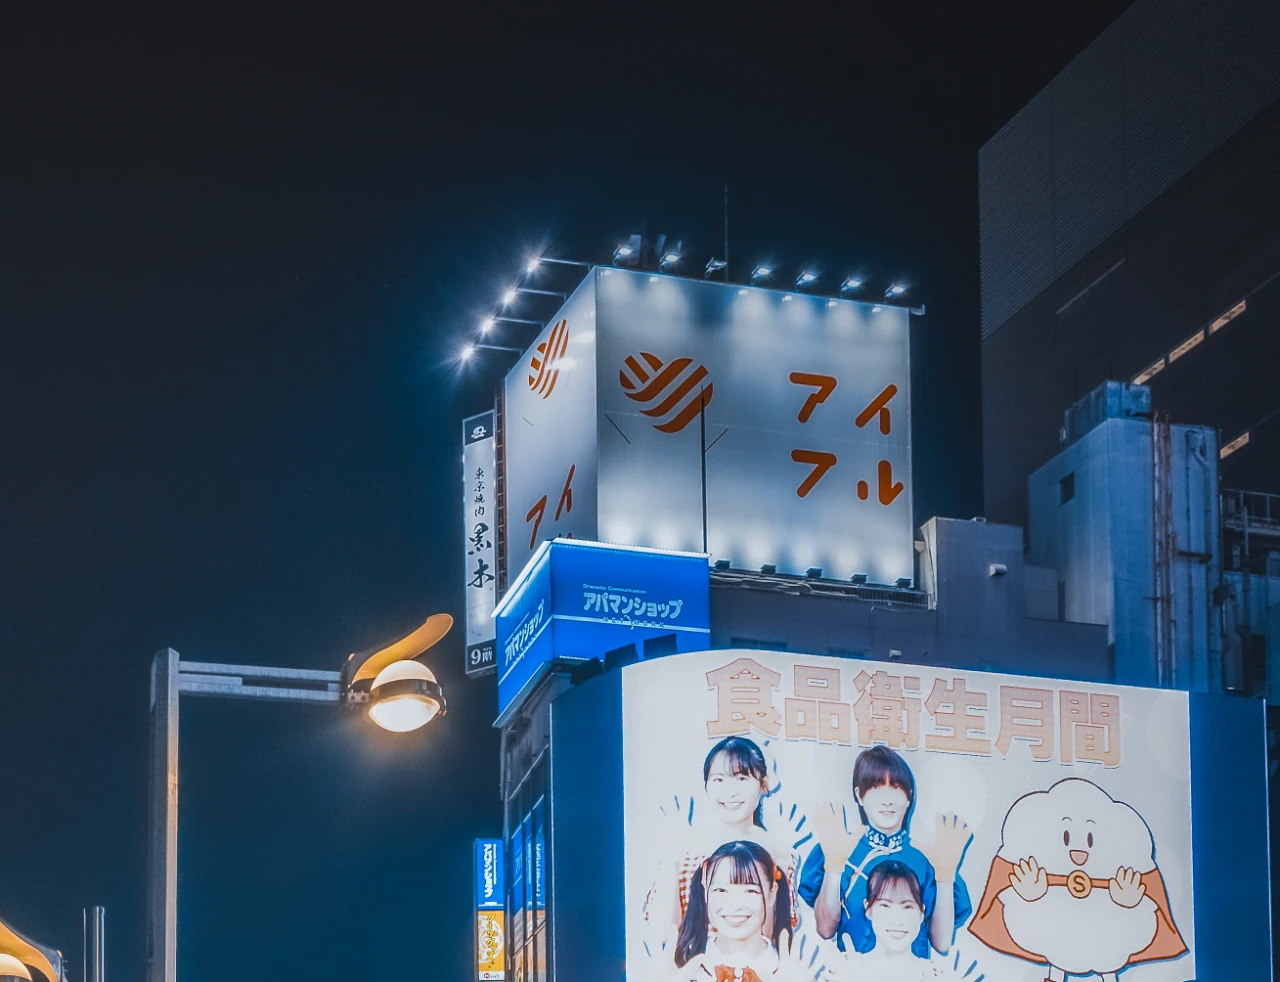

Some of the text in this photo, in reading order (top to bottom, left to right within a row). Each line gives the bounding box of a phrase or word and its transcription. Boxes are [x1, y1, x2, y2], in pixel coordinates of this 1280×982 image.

[789, 371, 898, 435] アイ
[525, 463, 576, 550] アイ
[790, 448, 904, 506] フル
[467, 522, 495, 588] 黒木
[504, 598, 545, 667] アパマンショップ
[583, 591, 684, 619] アパマンショップ
[704, 656, 1122, 770] 食品衛生月間
